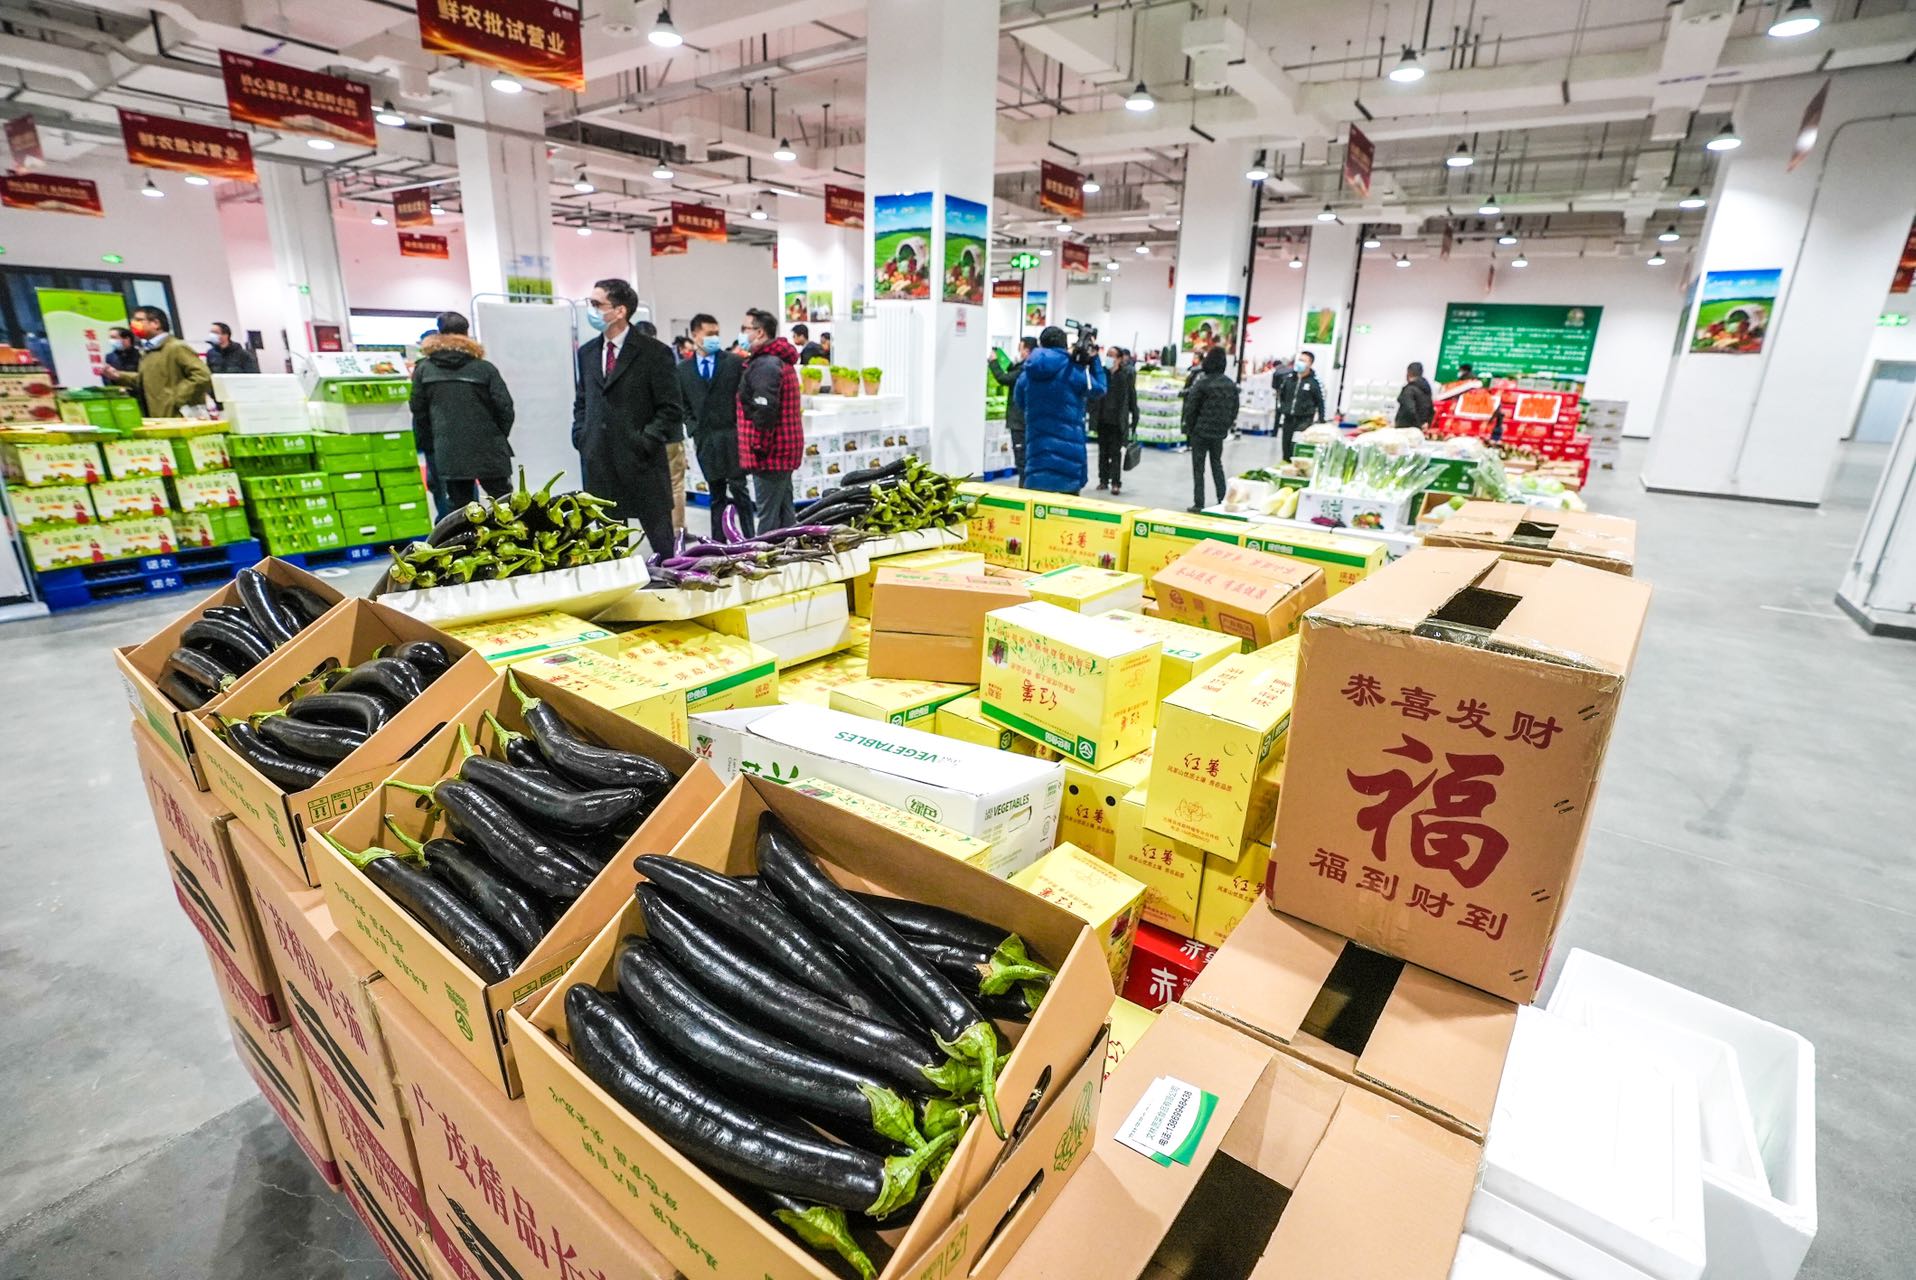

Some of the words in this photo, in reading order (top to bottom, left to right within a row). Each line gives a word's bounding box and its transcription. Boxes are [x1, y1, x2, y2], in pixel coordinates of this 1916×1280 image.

[1060, 530, 1088, 548] 红薯
[1341, 673, 1564, 749] 恭喜发财
[835, 730, 939, 763] VEGETABLES
[1184, 752, 1220, 778] 红薯
[910, 798, 938, 823] 绿色
[993, 793, 1030, 817] VEGETABLES
[1075, 804, 1105, 824] 红薯
[1347, 733, 1510, 889] 福
[1140, 843, 1174, 866] 红薯
[1309, 848, 1509, 941] 福到财到
[256, 887, 369, 1057] 广茂精品长茄
[1149, 966, 1178, 1004] 赤
[548, 1086, 605, 1145] 安全放心
[411, 1081, 608, 1280] 广茂精品长
[613, 1145, 679, 1212] 绿色食品
